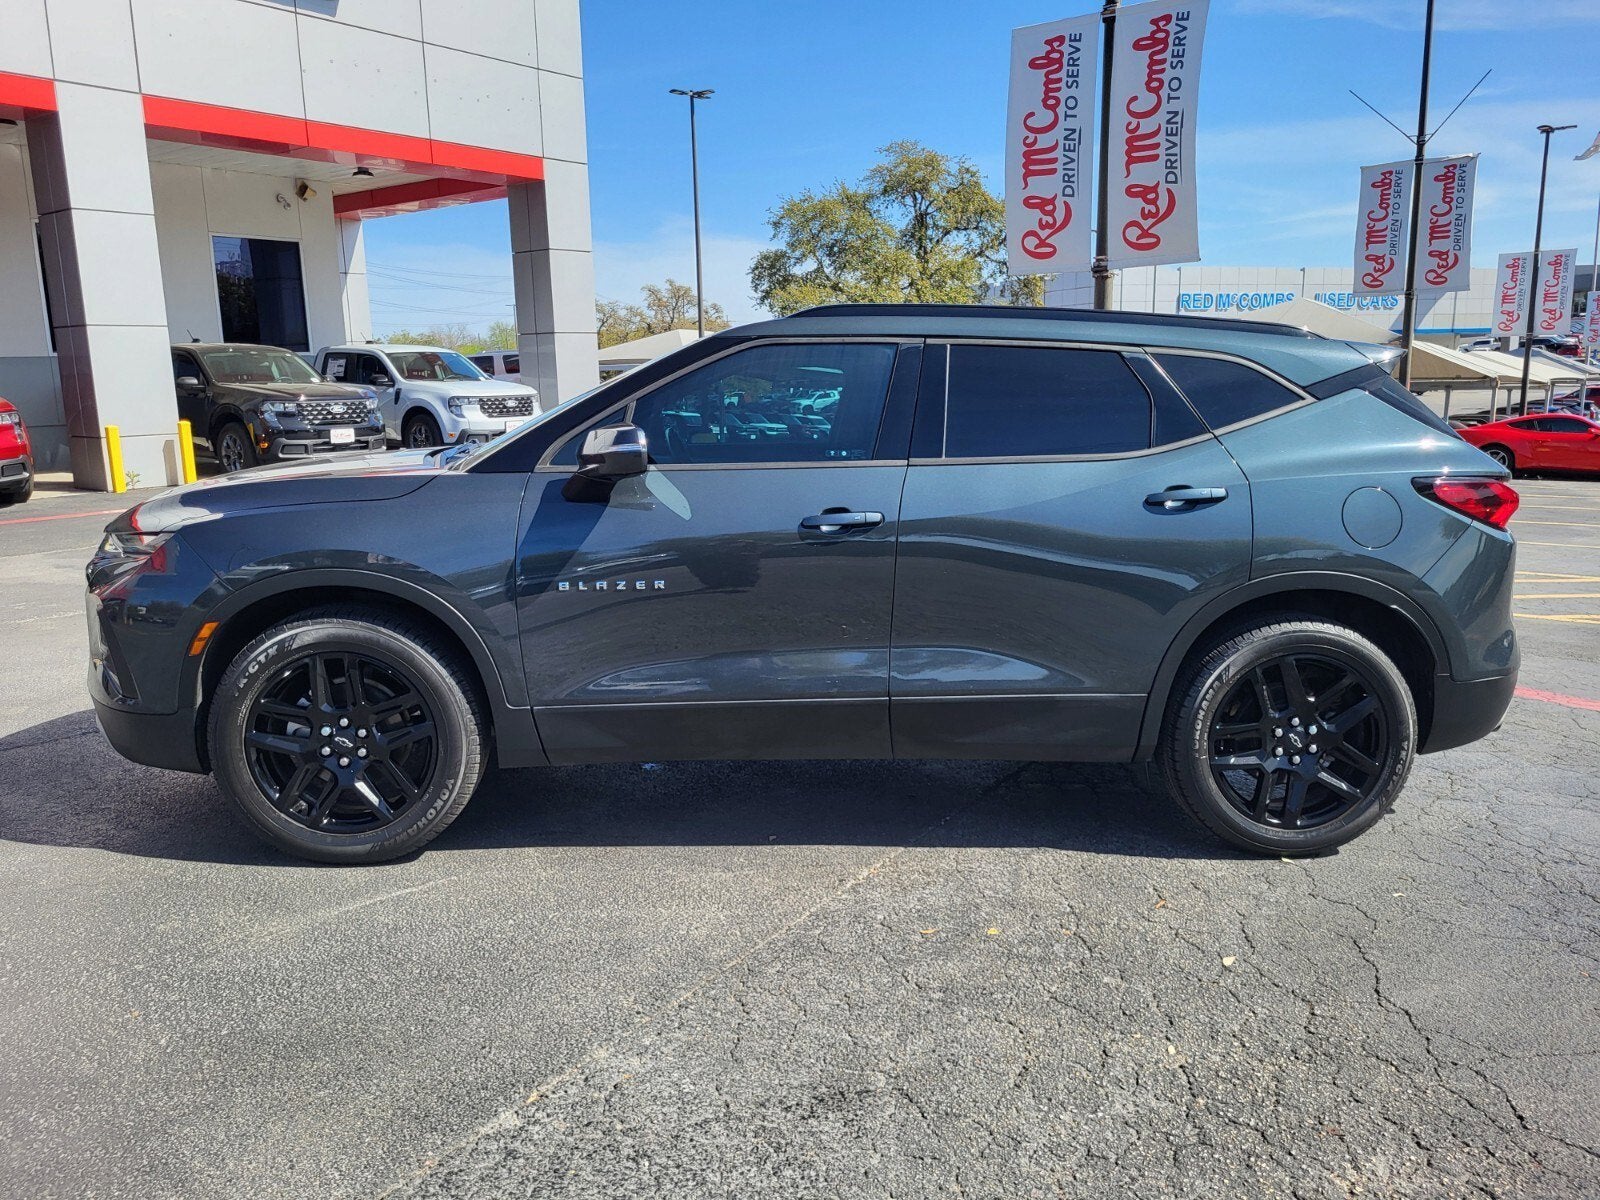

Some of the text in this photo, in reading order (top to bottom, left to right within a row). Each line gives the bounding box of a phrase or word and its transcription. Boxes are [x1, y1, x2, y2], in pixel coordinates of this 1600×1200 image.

[1021, 34, 1072, 260] Red McCombs
[1062, 32, 1082, 198] DRIVEN TO SERVE
[1122, 13, 1176, 251] Red McCombs
[1165, 10, 1190, 185] DRIVEN TO SERVE
[1361, 169, 1395, 289] Red McCombs
[1389, 168, 1403, 256] DRIVEN TO SERVE
[1424, 163, 1459, 286] Red McCombs
[1453, 162, 1468, 251] DRIVEN TO SERVE
[1180, 293, 1213, 308] RED
[1315, 292, 1356, 307] USED
[1360, 295, 1398, 307] CARS
[1498, 257, 1521, 332] Red McCombs
[1540, 253, 1564, 330] Red McCombs
[558, 580, 665, 591] BLAZER
